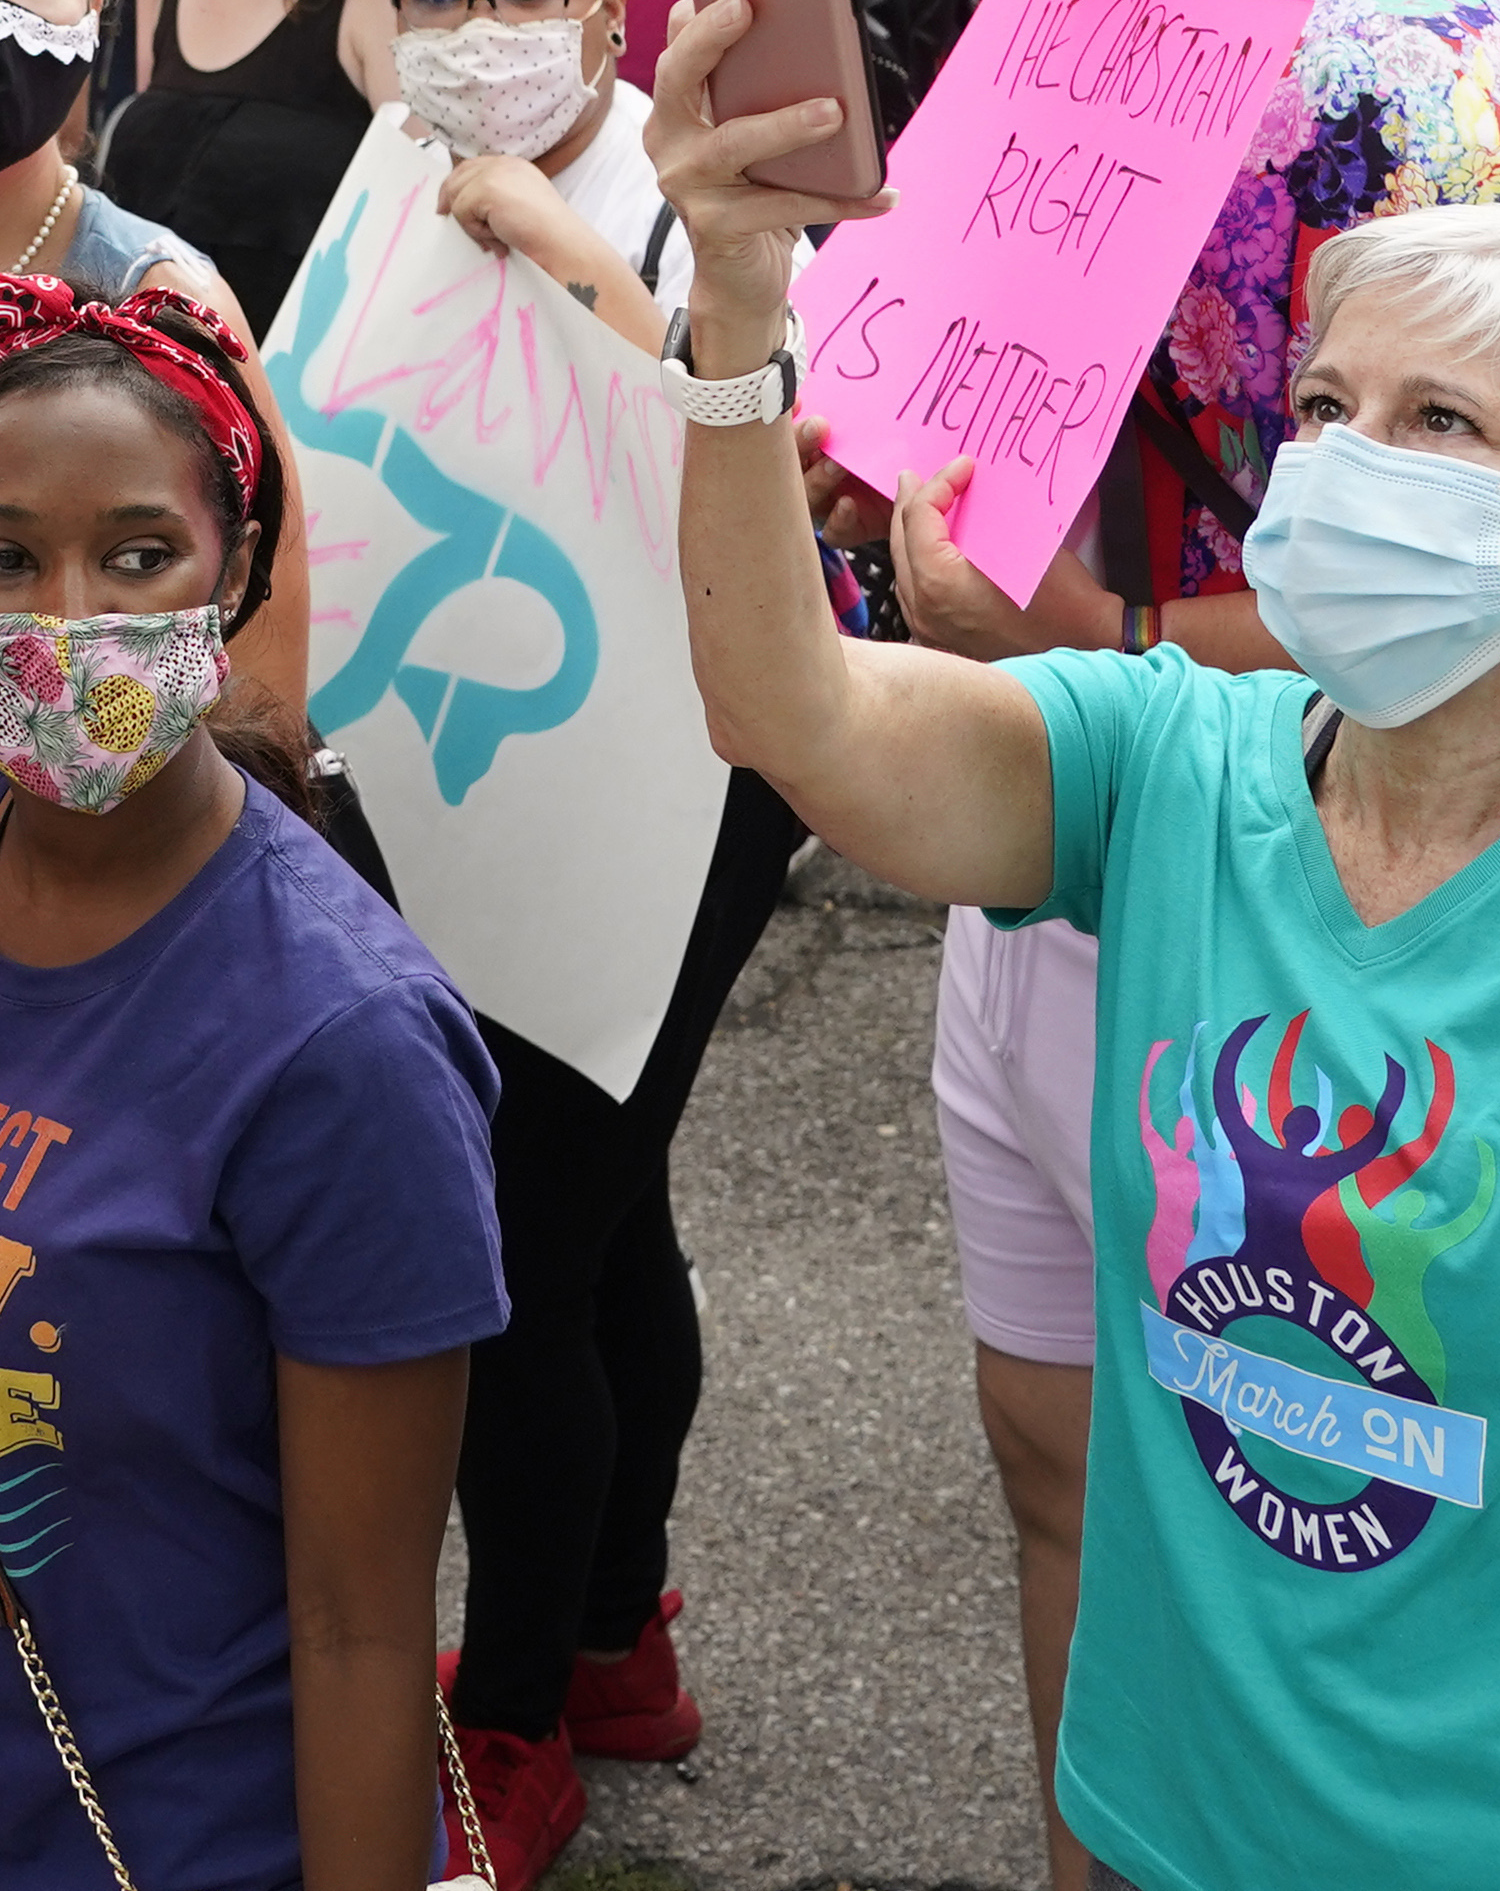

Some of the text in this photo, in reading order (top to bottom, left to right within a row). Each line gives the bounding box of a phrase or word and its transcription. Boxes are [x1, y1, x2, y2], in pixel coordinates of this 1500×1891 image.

[962, 130, 1163, 278] RIGHT
[810, 276, 905, 380] IS
[1174, 1264, 1406, 1381] HOUSTON
[1172, 1327, 1445, 1477] March ON
[1214, 1446, 1392, 1564] WOMEN
